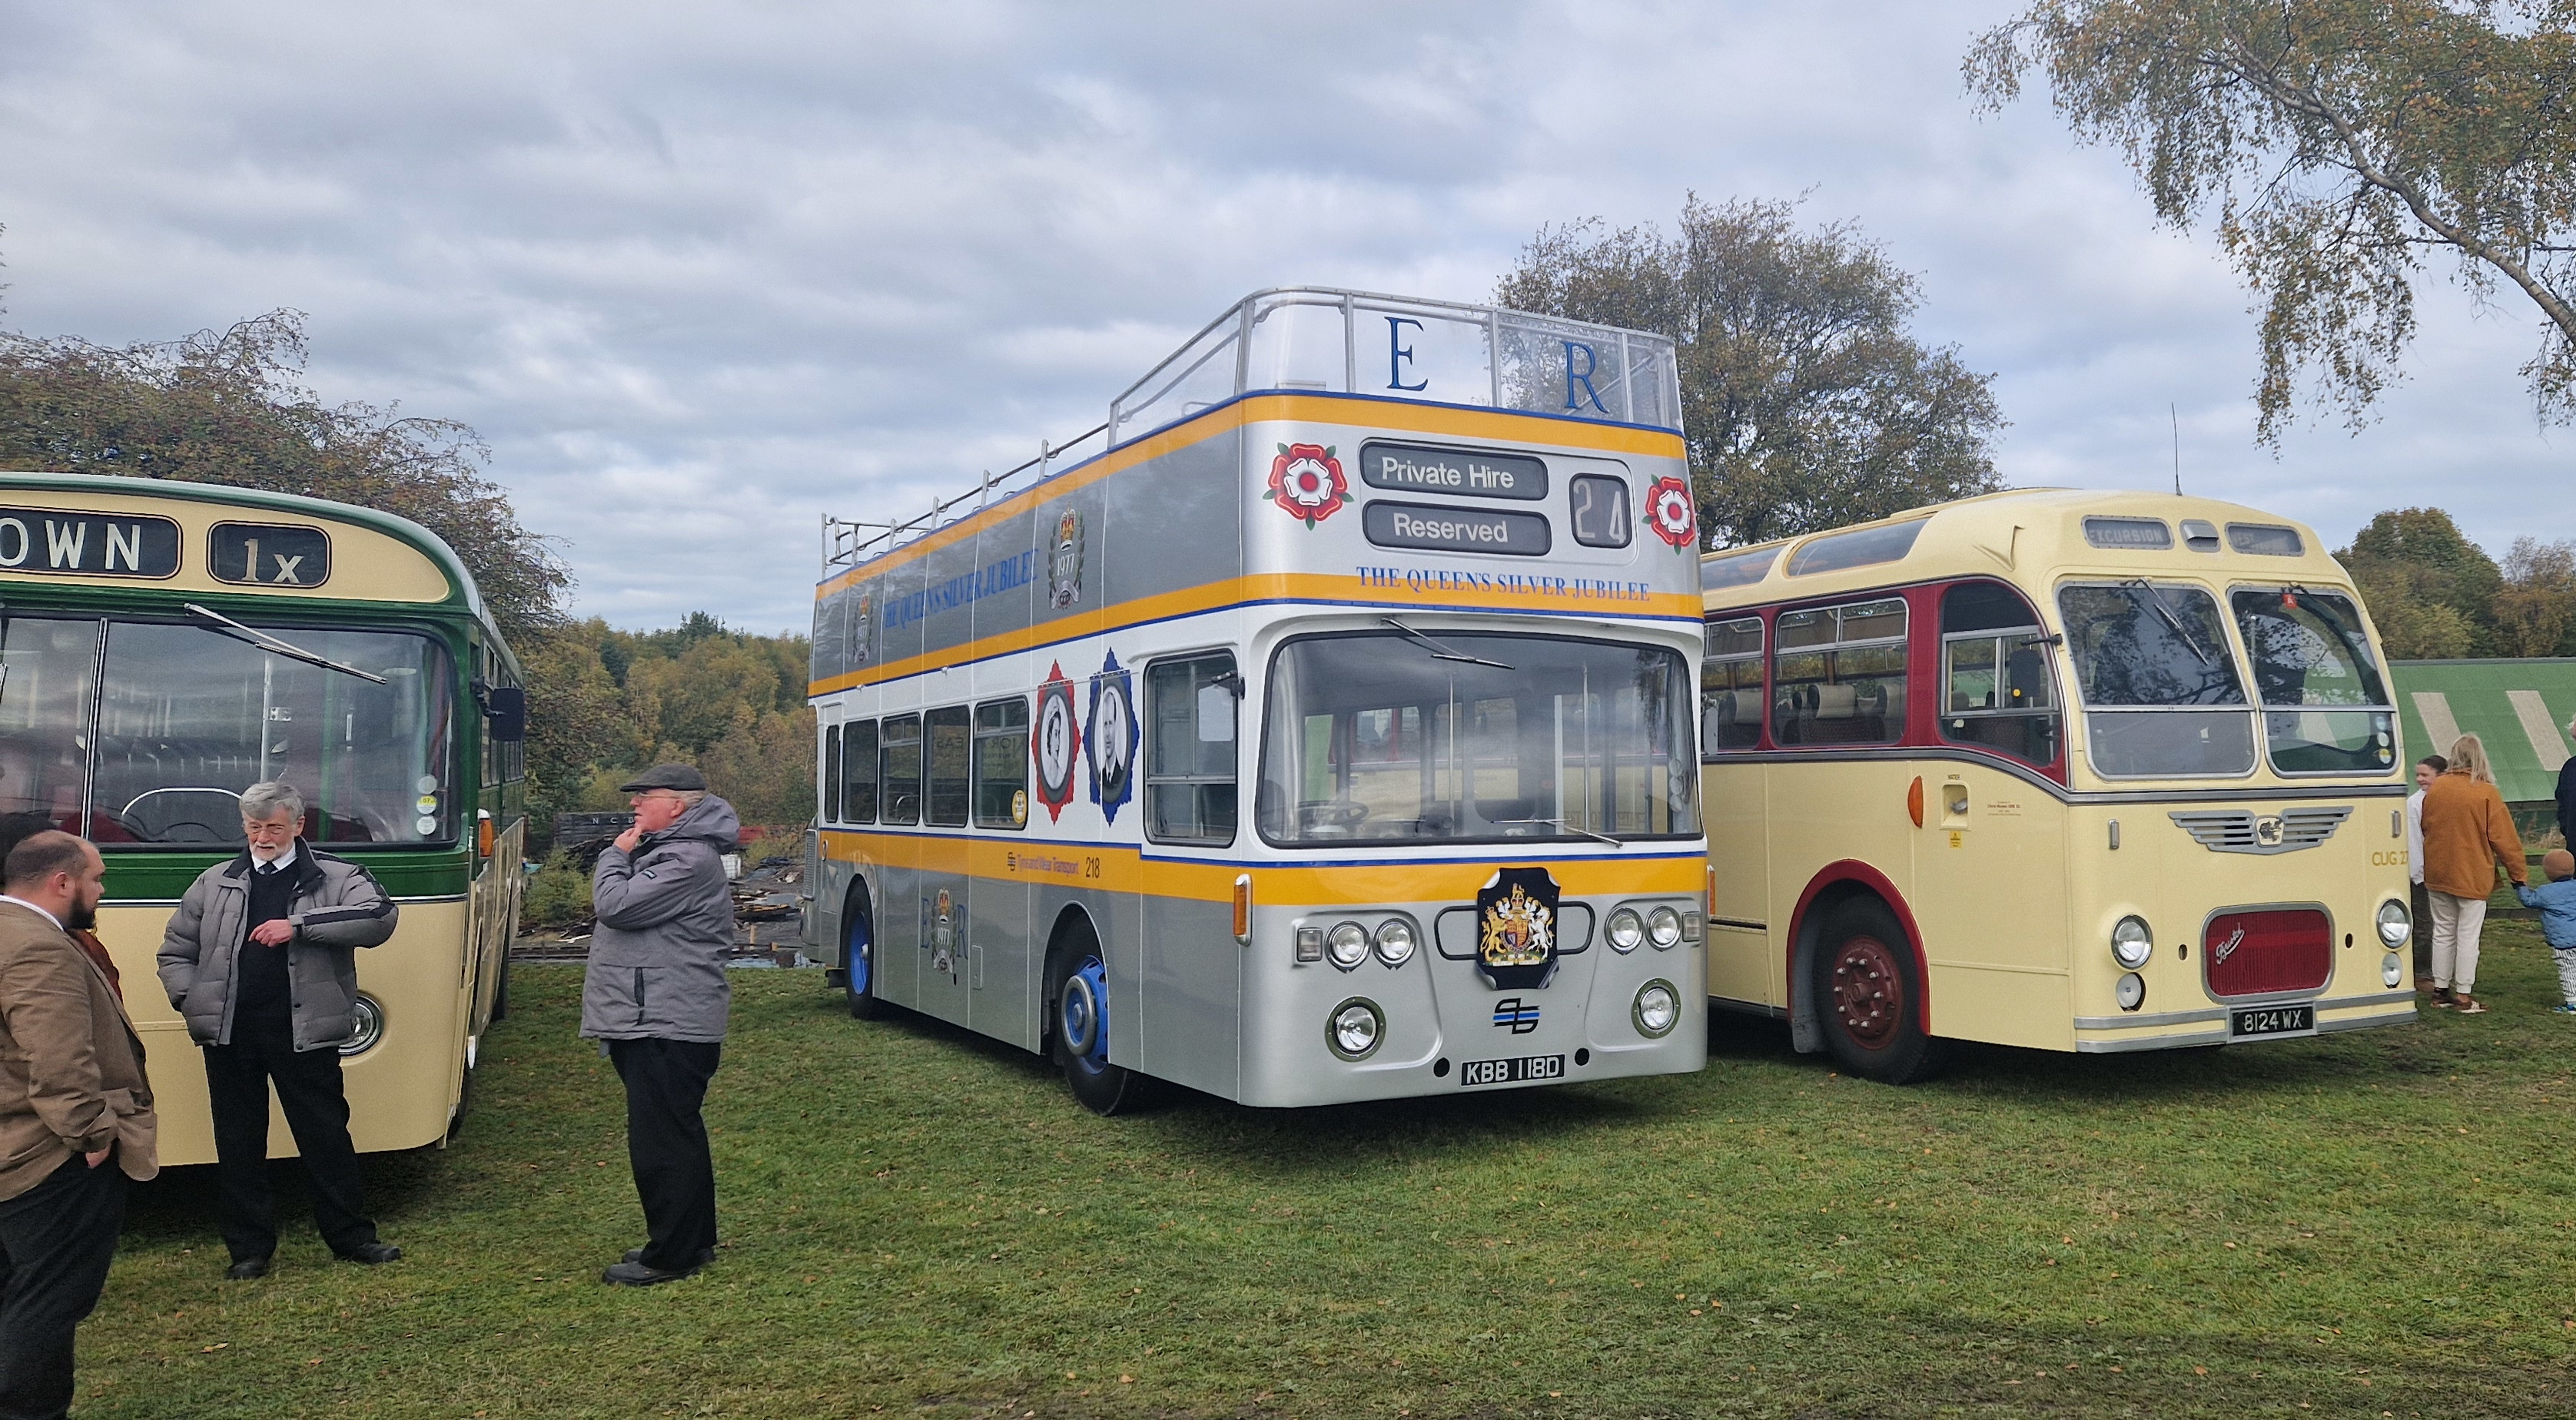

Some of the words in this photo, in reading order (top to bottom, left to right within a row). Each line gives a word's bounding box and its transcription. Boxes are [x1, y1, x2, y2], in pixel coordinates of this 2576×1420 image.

[1384, 316, 1429, 392] E
[1562, 340, 1611, 413] R
[1381, 456, 1462, 487] Private
[1469, 463, 1515, 489] Hire
[1393, 513, 1509, 543] Reserved
[2087, 529, 2164, 543] EXCURSION
[0, 517, 141, 571] OWN
[1057, 552, 1075, 577] 1977
[1356, 566, 1401, 589] THE
[1406, 569, 1491, 593] QUEEN'S
[1497, 574, 1567, 597] SILVER
[1572, 578, 1651, 602] JUBILEE
[1085, 857, 1100, 878] 218
[2372, 851, 2398, 866] CUG
[938, 927, 951, 947] 1977
[2243, 1011, 2279, 1033] 8124
[2282, 1010, 2303, 1030] WX
[1466, 1060, 1509, 1085] KBB
[1518, 1057, 1560, 1080] 118D
